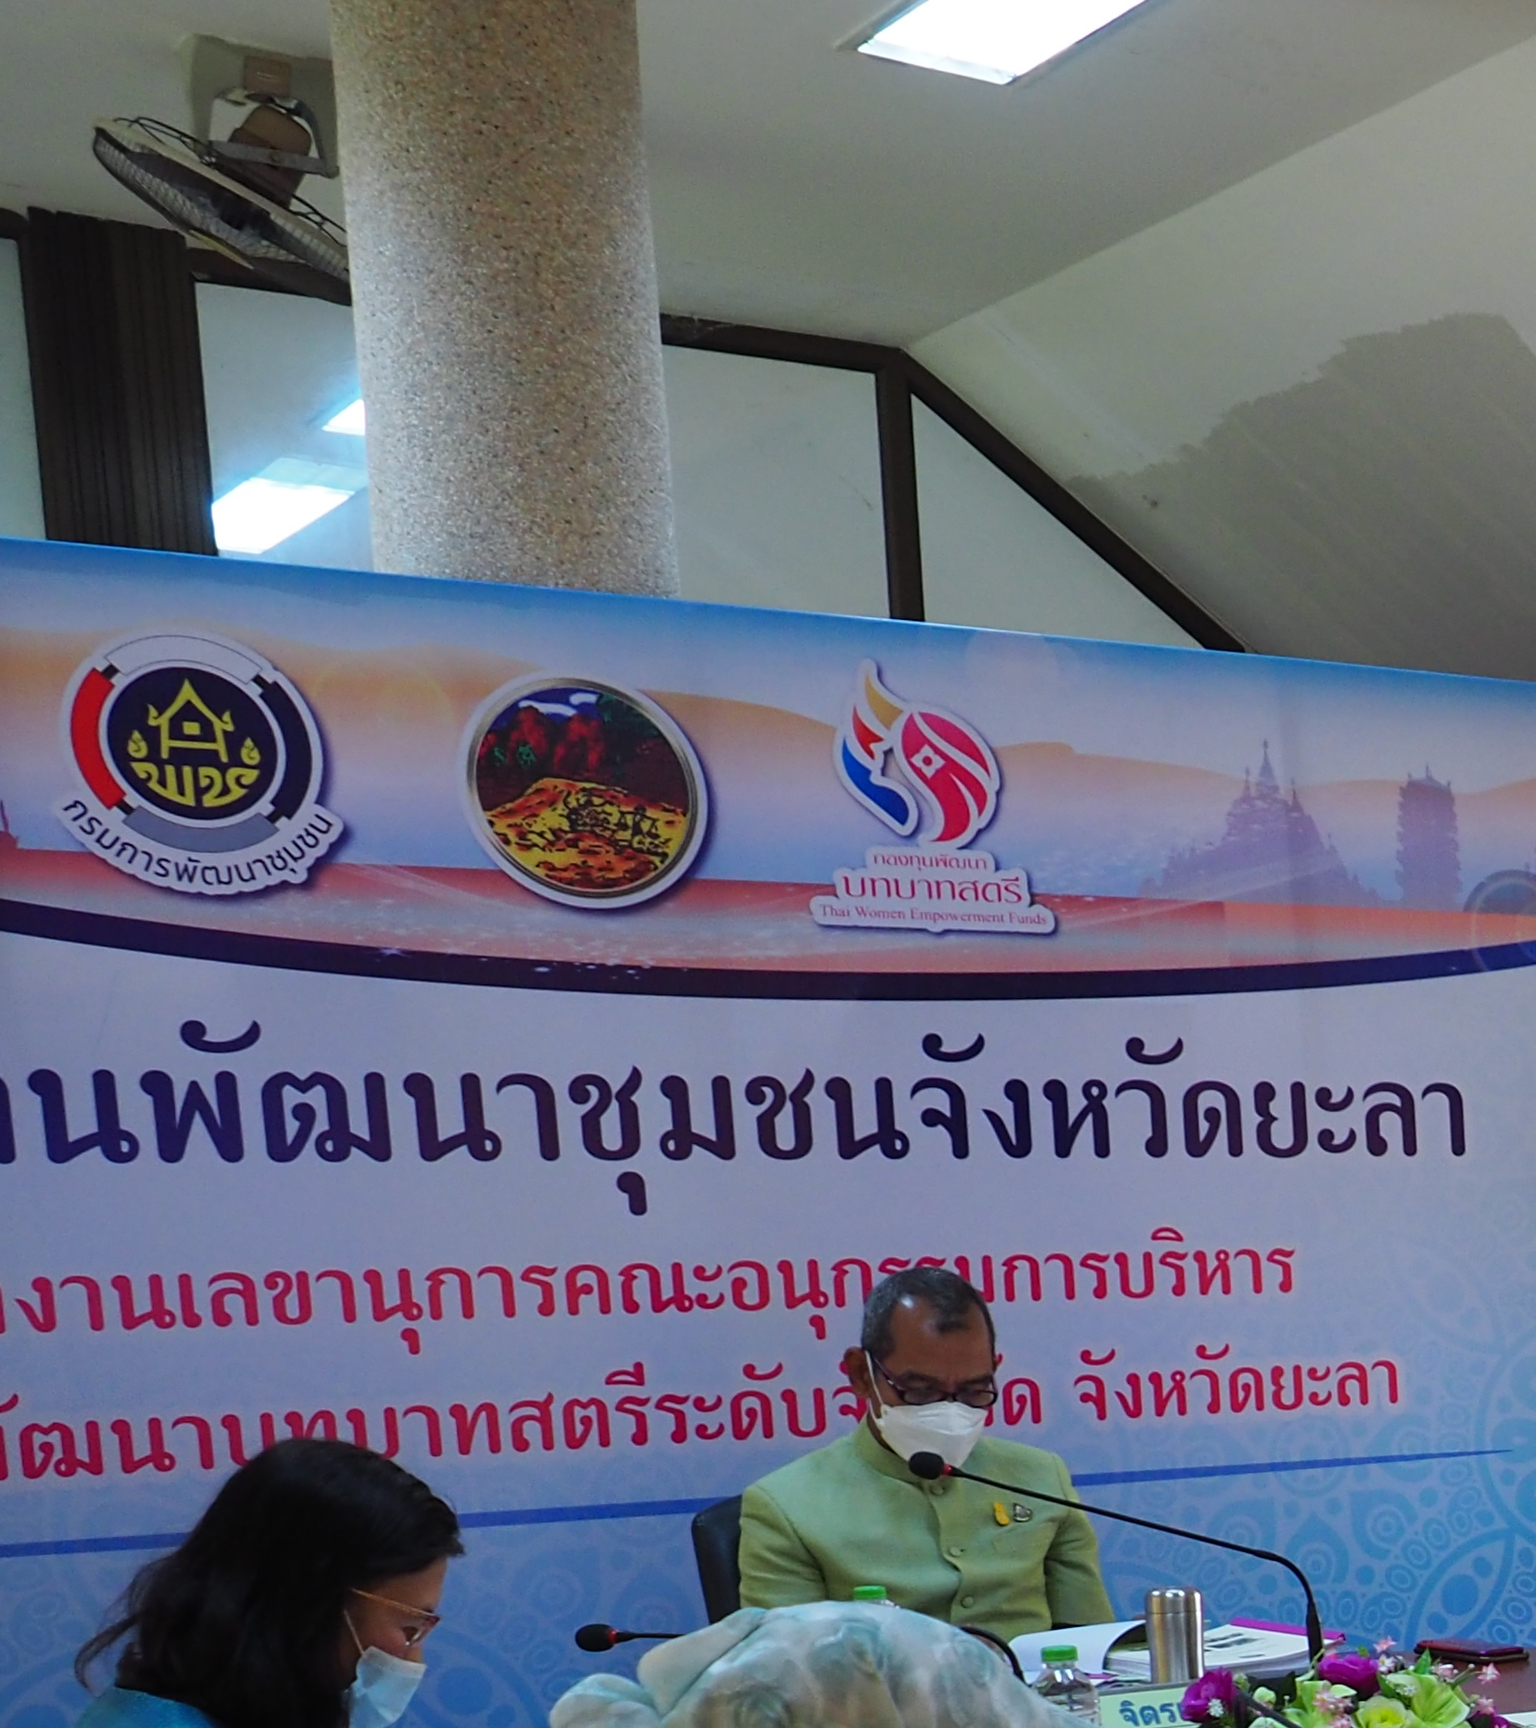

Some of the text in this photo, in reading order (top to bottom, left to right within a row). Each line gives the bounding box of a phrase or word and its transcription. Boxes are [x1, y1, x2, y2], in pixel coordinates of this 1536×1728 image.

[62, 799, 334, 886] กรมการพัฒนาชุมชน
[873, 853, 988, 872] กองทุนพัฒนา
[843, 876, 1022, 904] บทบาทสตรี
[819, 904, 1048, 926] Thai Women Empowerment Funds
[0, 1019, 1467, 1217] นพัฒนาชุมชนจังหวัดยะลา
[1074, 1344, 1400, 1421] จังหวัดยะลา
[1118, 1700, 1184, 1727] จิตร
